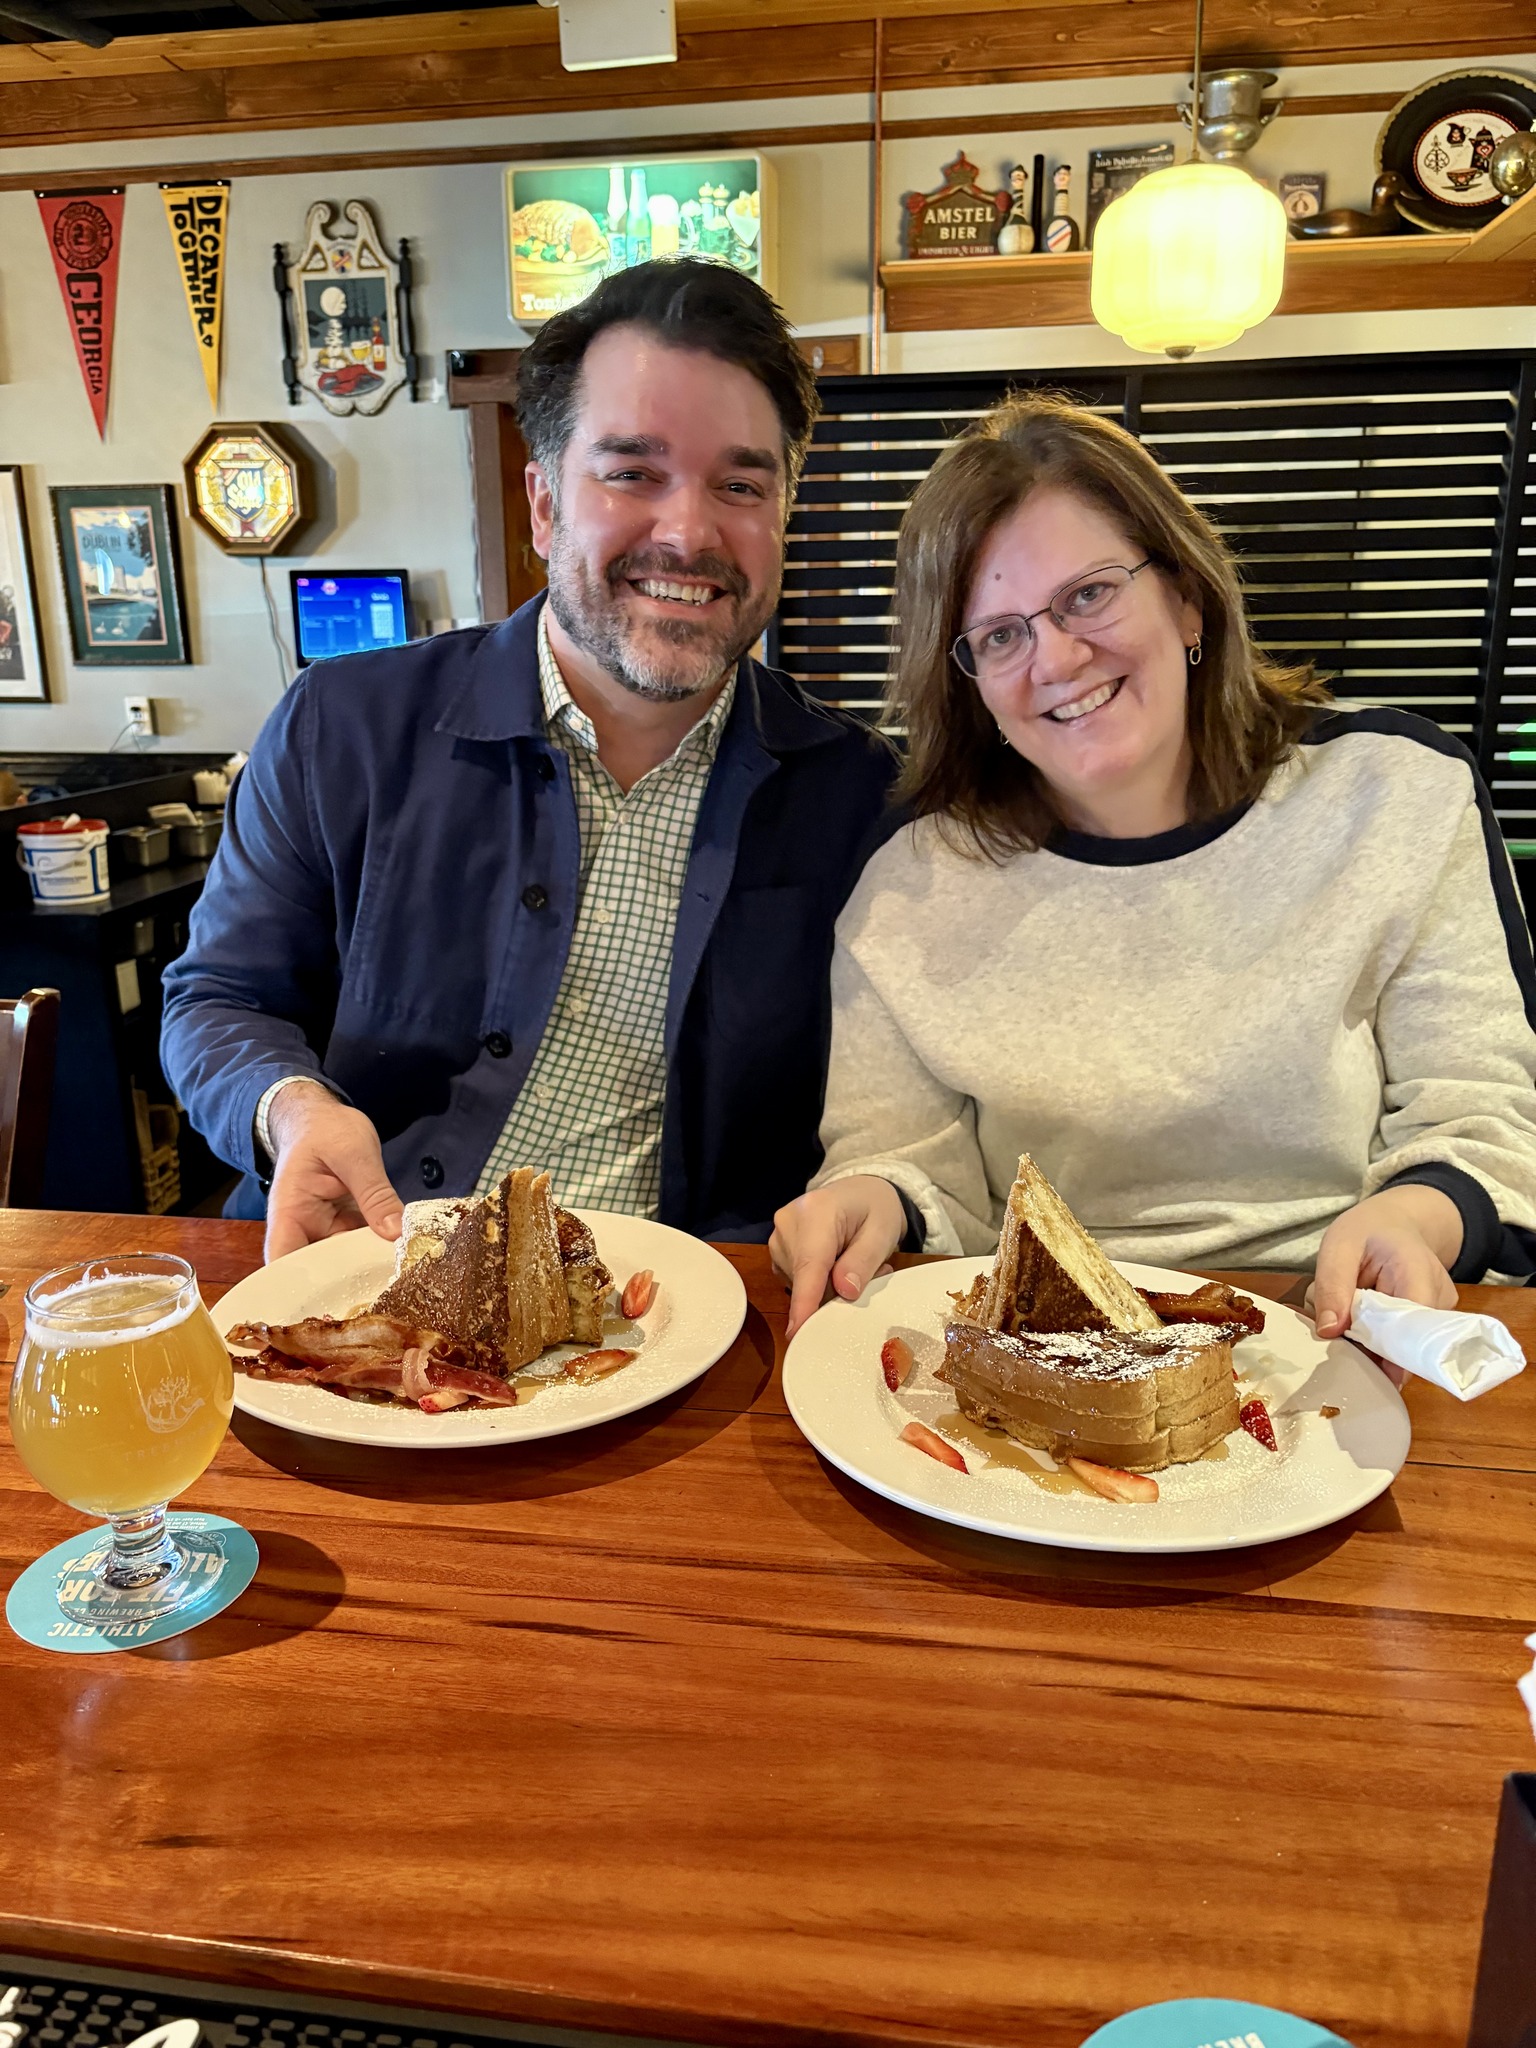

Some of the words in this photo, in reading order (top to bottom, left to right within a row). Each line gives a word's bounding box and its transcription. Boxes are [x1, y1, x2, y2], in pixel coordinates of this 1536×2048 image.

[923, 206, 995, 224] AMSTEL
[939, 226, 977, 240] BIER
[194, 196, 222, 336] DECATUR
[66, 272, 103, 395] GEORGIA
[236, 470, 261, 491] Old
[82, 533, 121, 549] DUBLIN
[89, 1607, 143, 1616] BREWING
[47, 1622, 153, 1637] ATHLETIC
